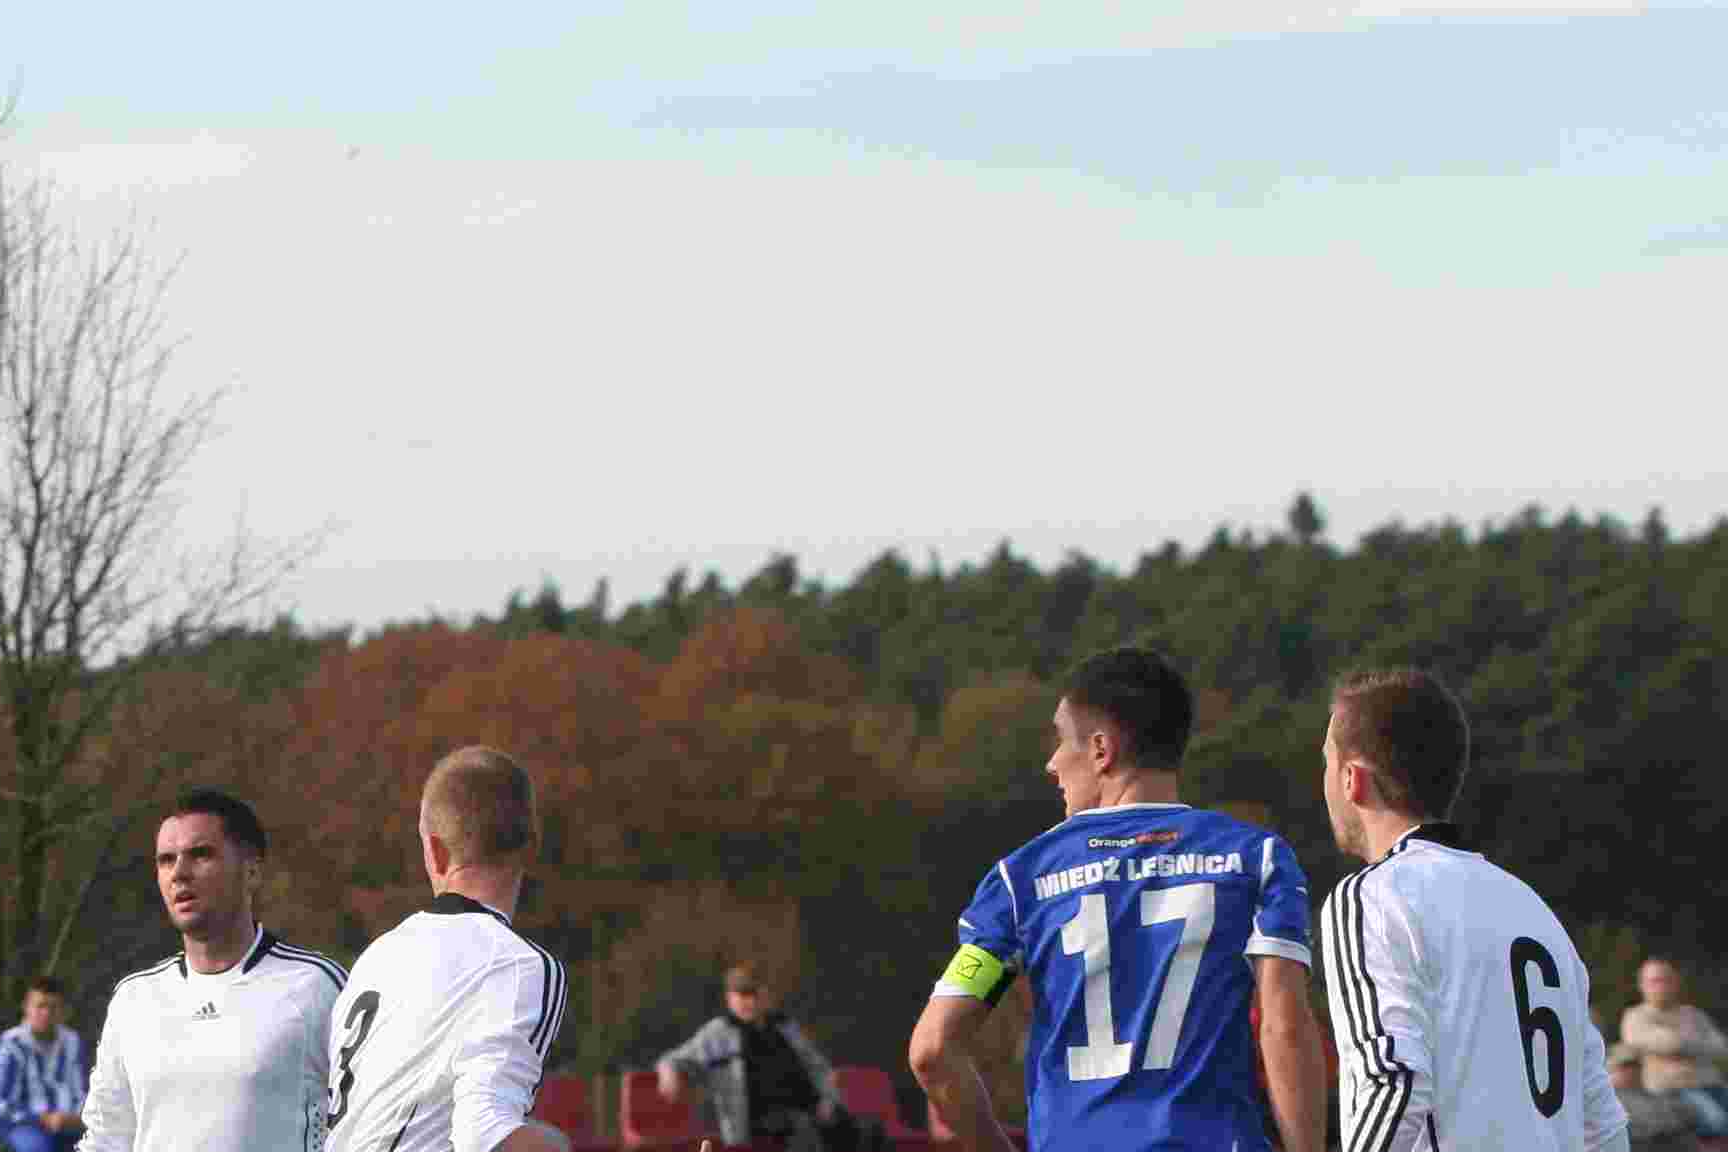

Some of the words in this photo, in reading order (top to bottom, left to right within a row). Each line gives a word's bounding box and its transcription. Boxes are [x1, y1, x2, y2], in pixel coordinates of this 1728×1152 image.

[1128, 852, 1243, 880] LEGNICA
[327, 989, 381, 1131] 3
[1059, 882, 1216, 1081] 17
[1509, 935, 1566, 1118] 6
